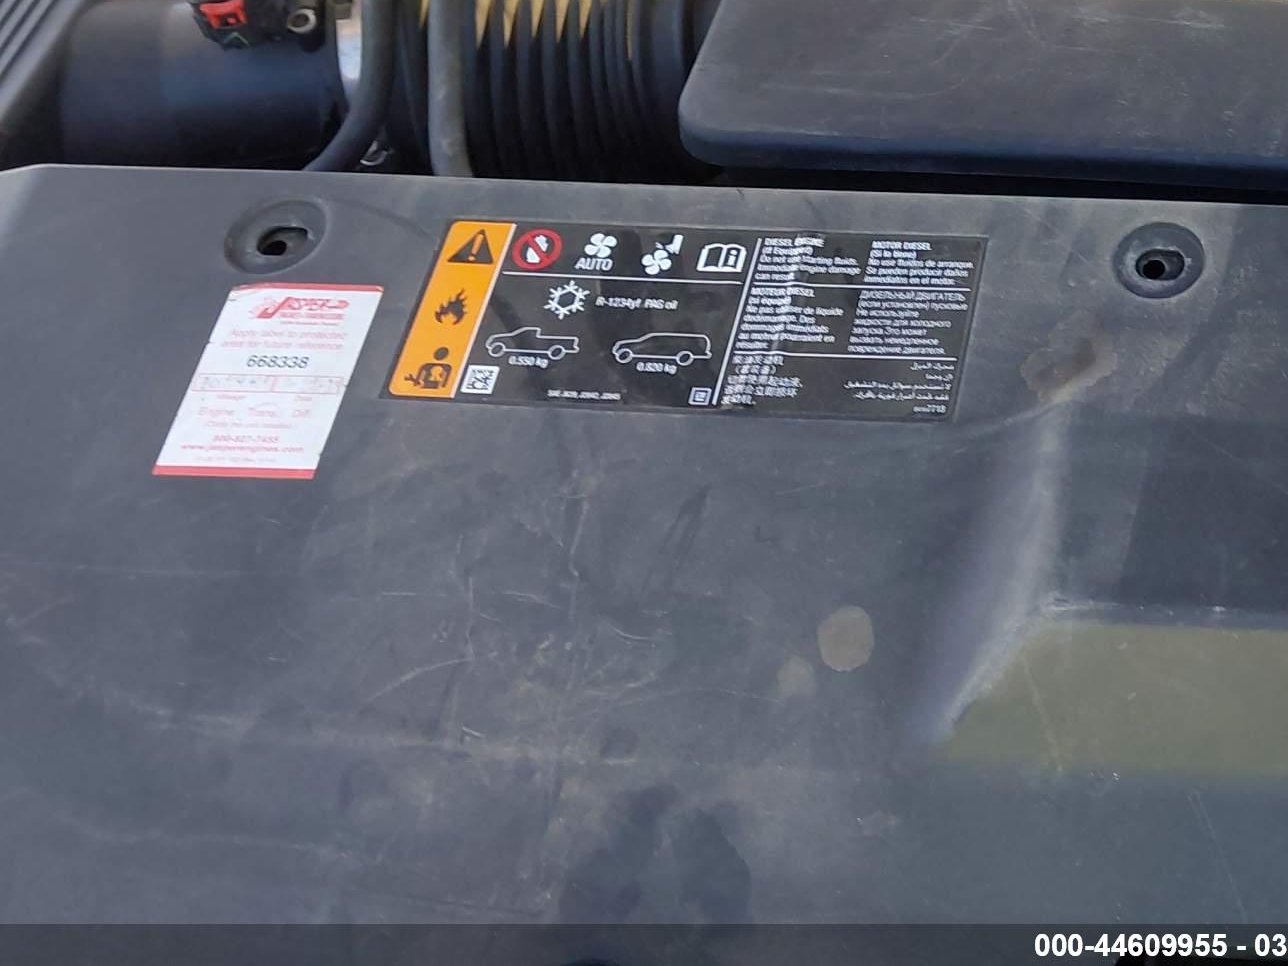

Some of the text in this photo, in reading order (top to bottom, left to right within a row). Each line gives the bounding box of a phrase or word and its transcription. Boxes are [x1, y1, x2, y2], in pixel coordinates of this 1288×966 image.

[574, 257, 613, 272] AUTO
[595, 296, 641, 310] R-1234yf
[644, 298, 664, 309] PAG
[246, 354, 310, 369] 668338
[536, 356, 549, 369] kg
[664, 363, 678, 376] kg
